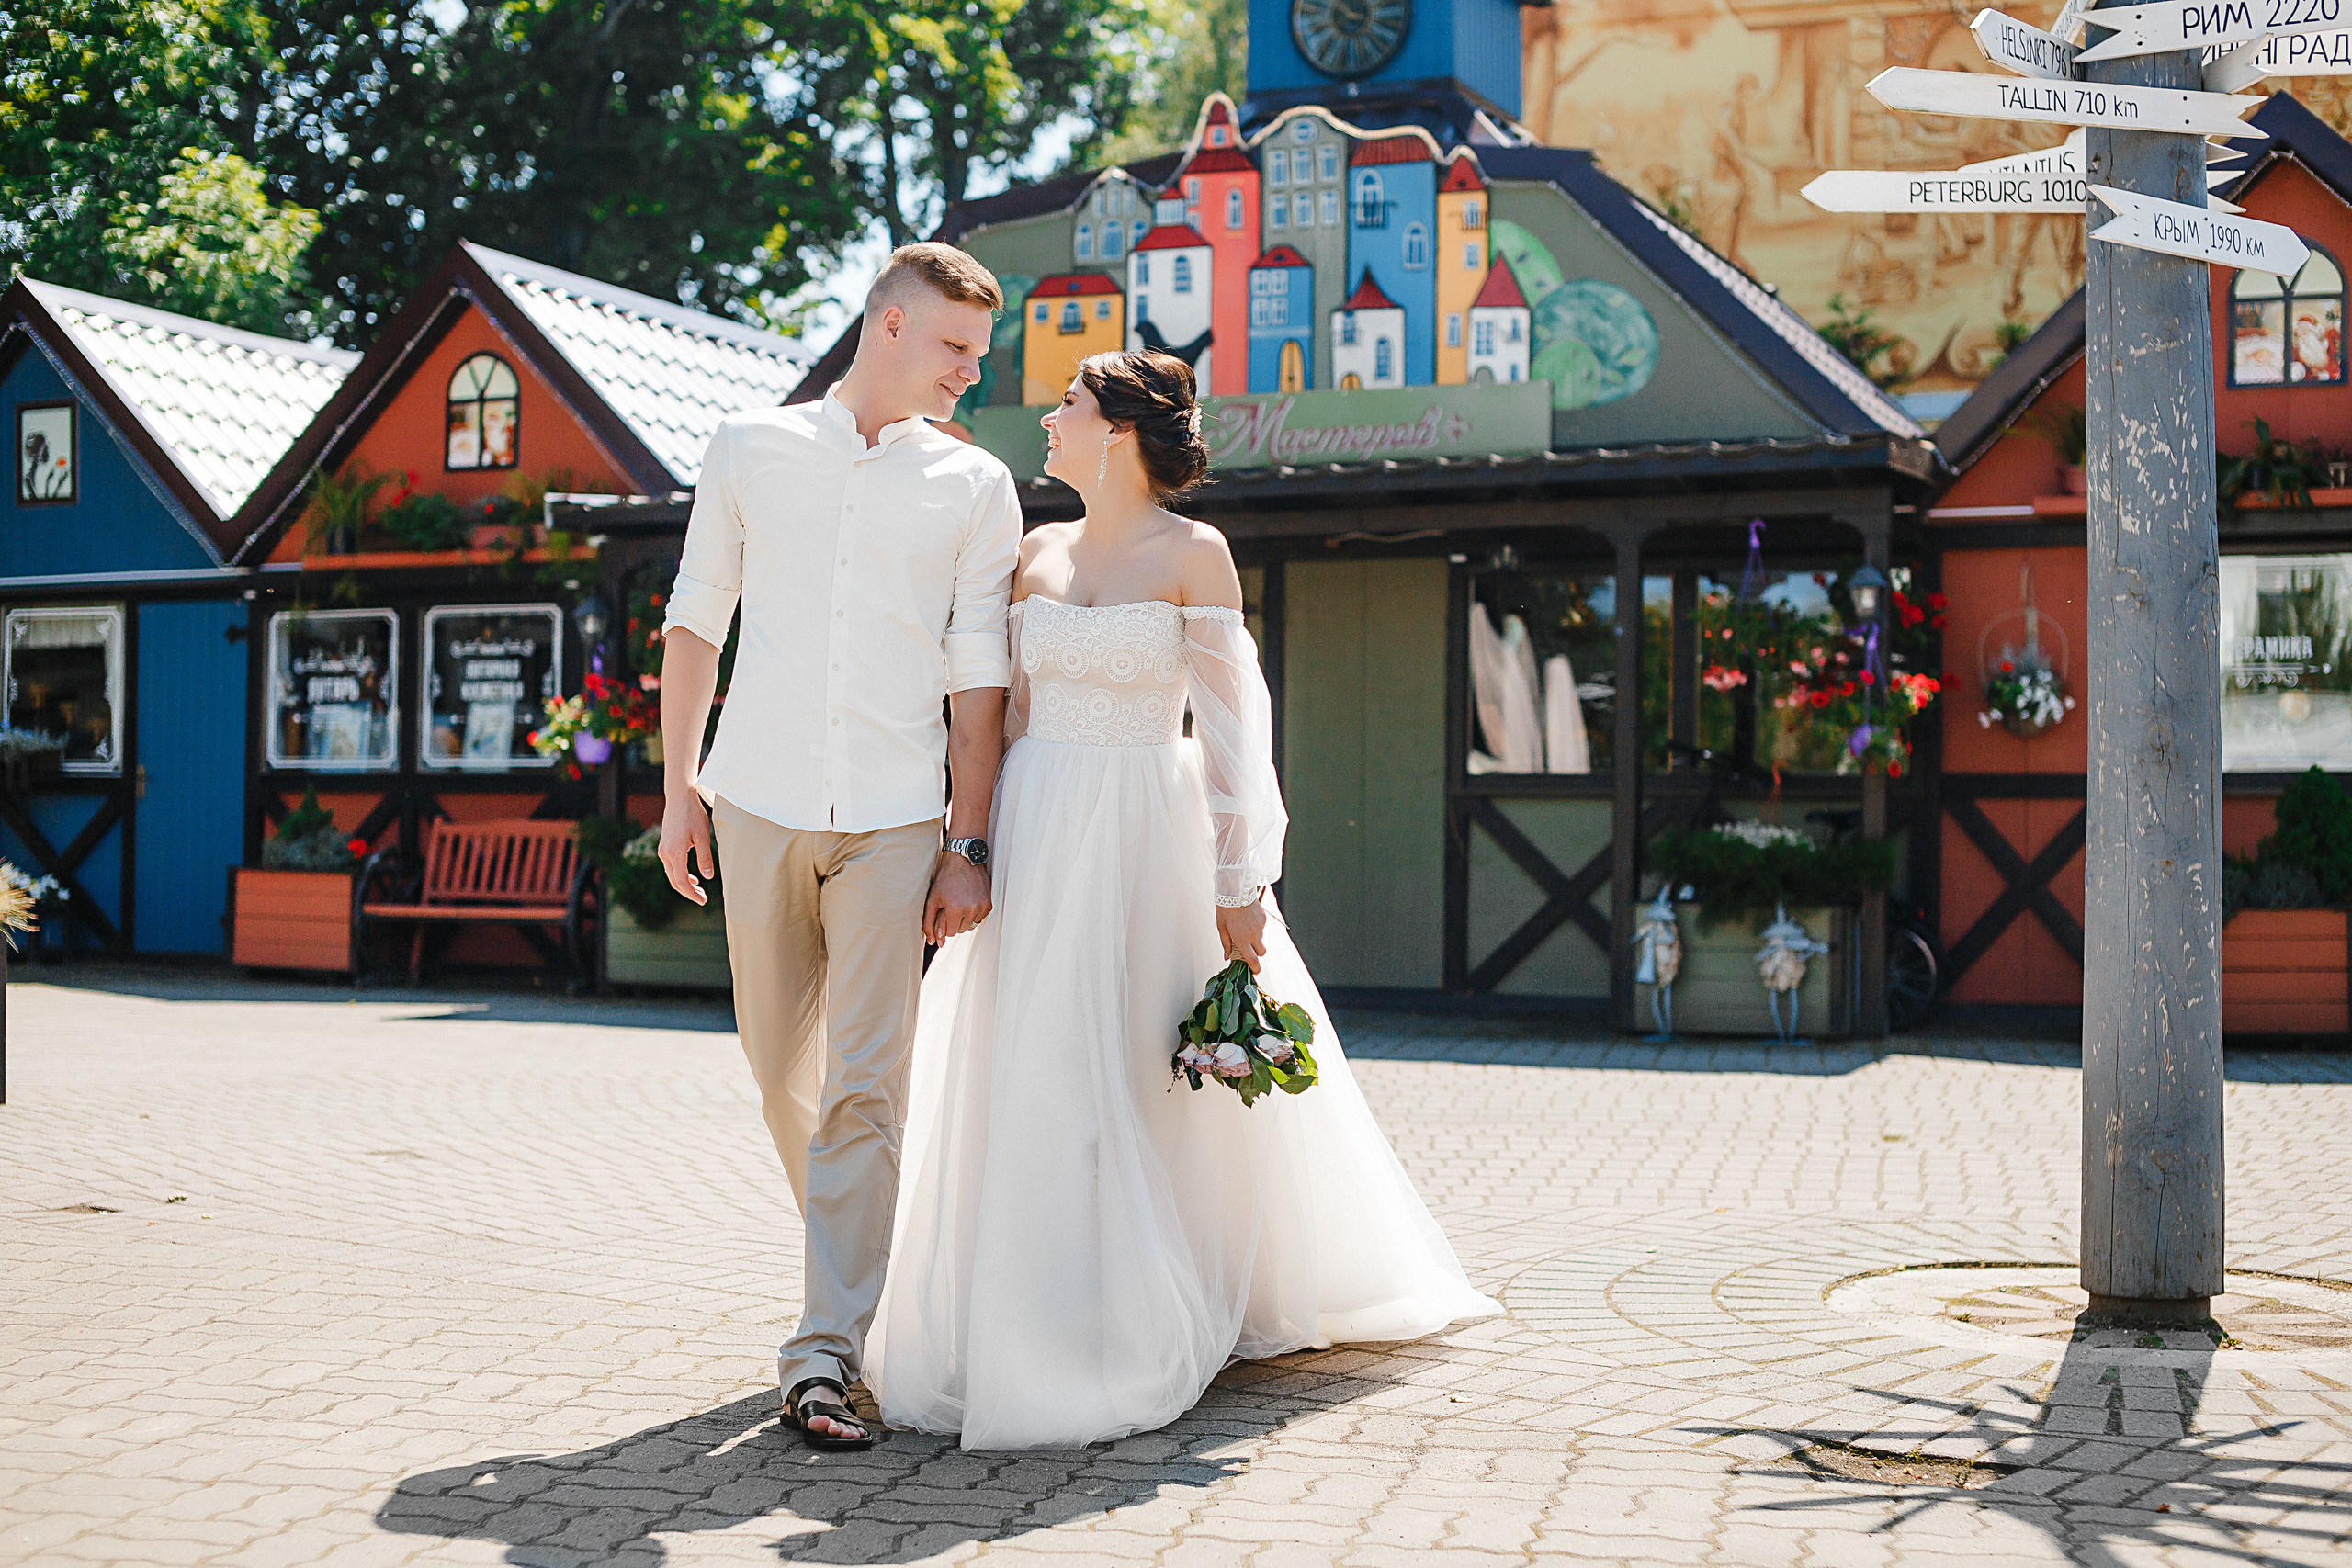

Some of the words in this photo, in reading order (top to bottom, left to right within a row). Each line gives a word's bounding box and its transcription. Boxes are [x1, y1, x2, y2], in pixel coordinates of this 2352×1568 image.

[2182, 1, 2253, 39] РИМ
[2266, 0, 2340, 28] 2220
[2001, 23, 2047, 70] HELSINKI
[2049, 40, 2067, 77] 796
[1997, 85, 2067, 113] TALLIN
[2074, 90, 2107, 116] 710
[2113, 95, 2139, 118] km
[1909, 179, 2033, 204] PETERBURG
[2041, 179, 2087, 203] 1010
[2154, 212, 2200, 246] КРЫМ
[2209, 222, 2242, 254] 1990
[1204, 396, 1443, 464] Мастеров
